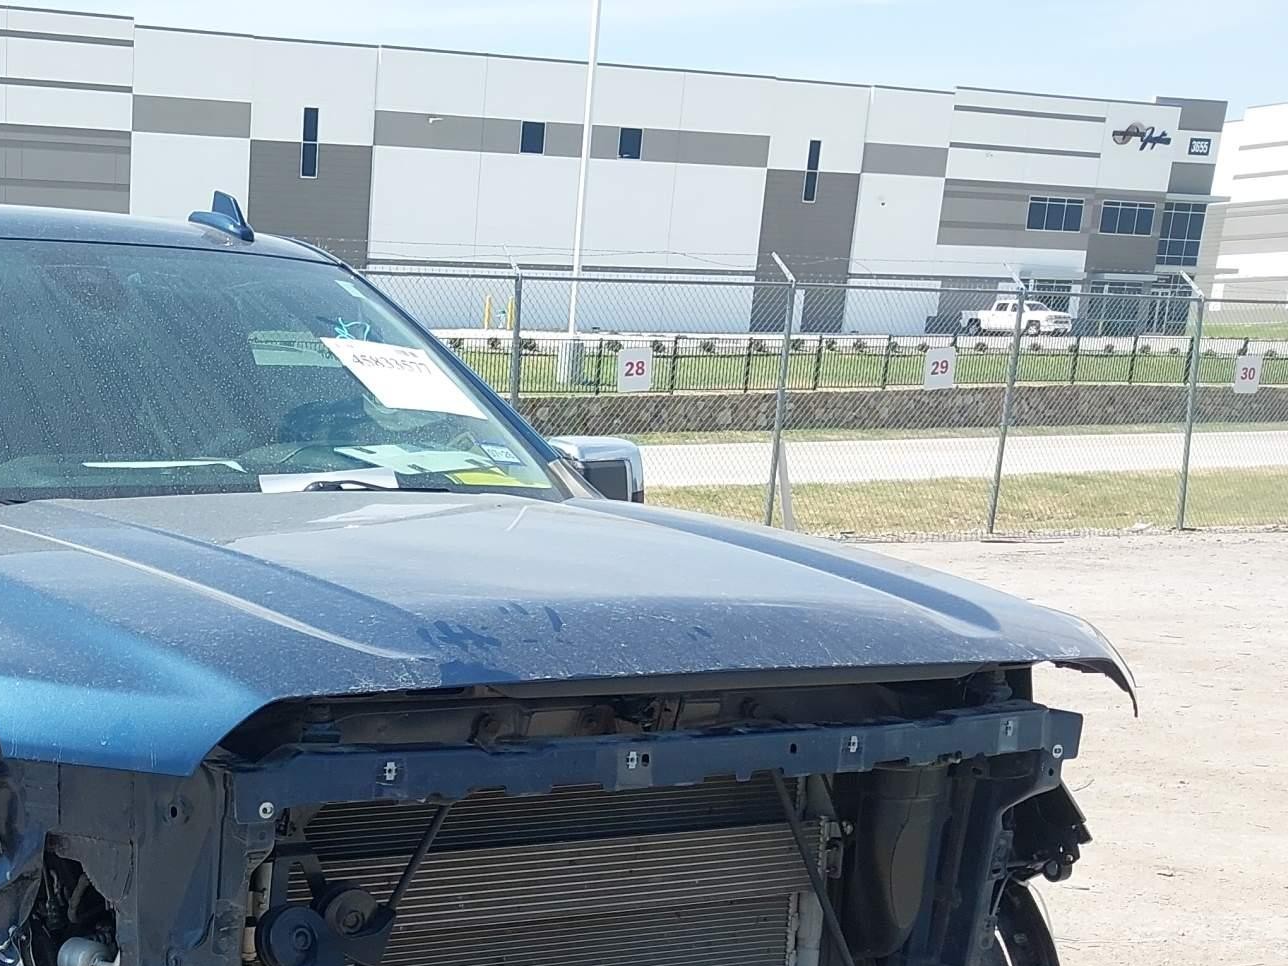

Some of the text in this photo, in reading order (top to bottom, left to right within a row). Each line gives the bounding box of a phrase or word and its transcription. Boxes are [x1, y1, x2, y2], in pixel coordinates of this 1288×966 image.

[624, 360, 645, 377] 28
[930, 359, 949, 376] 29
[1240, 367, 1256, 380] 30
